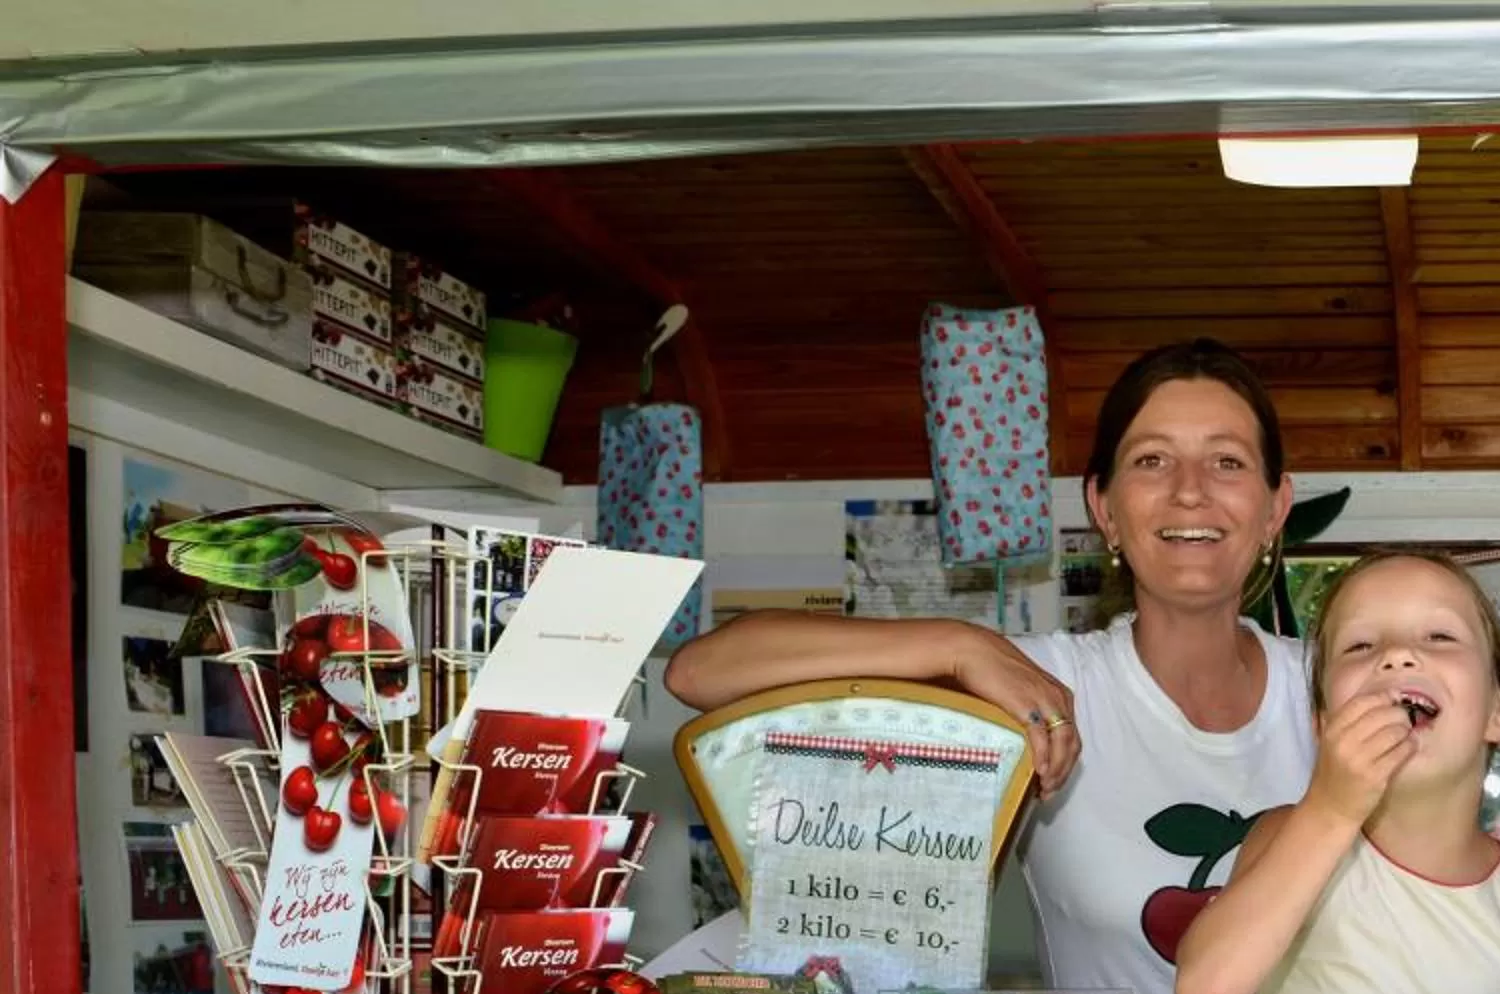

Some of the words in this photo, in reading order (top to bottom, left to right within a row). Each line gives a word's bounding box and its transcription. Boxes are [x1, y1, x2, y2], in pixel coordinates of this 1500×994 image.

[491, 746, 573, 769] Kersen
[768, 797, 865, 851] Deilse
[876, 805, 983, 861] Kersen
[493, 848, 575, 870] Kersen
[270, 892, 354, 927] kersen
[787, 879, 796, 896] 1
[808, 874, 859, 900] kilo
[893, 888, 908, 905] €
[925, 886, 956, 913] 6,-
[776, 916, 790, 934] 2
[800, 913, 851, 940] kilo
[885, 927, 899, 945] €
[916, 930, 960, 954] 10,-
[501, 945, 579, 969] Kersen
